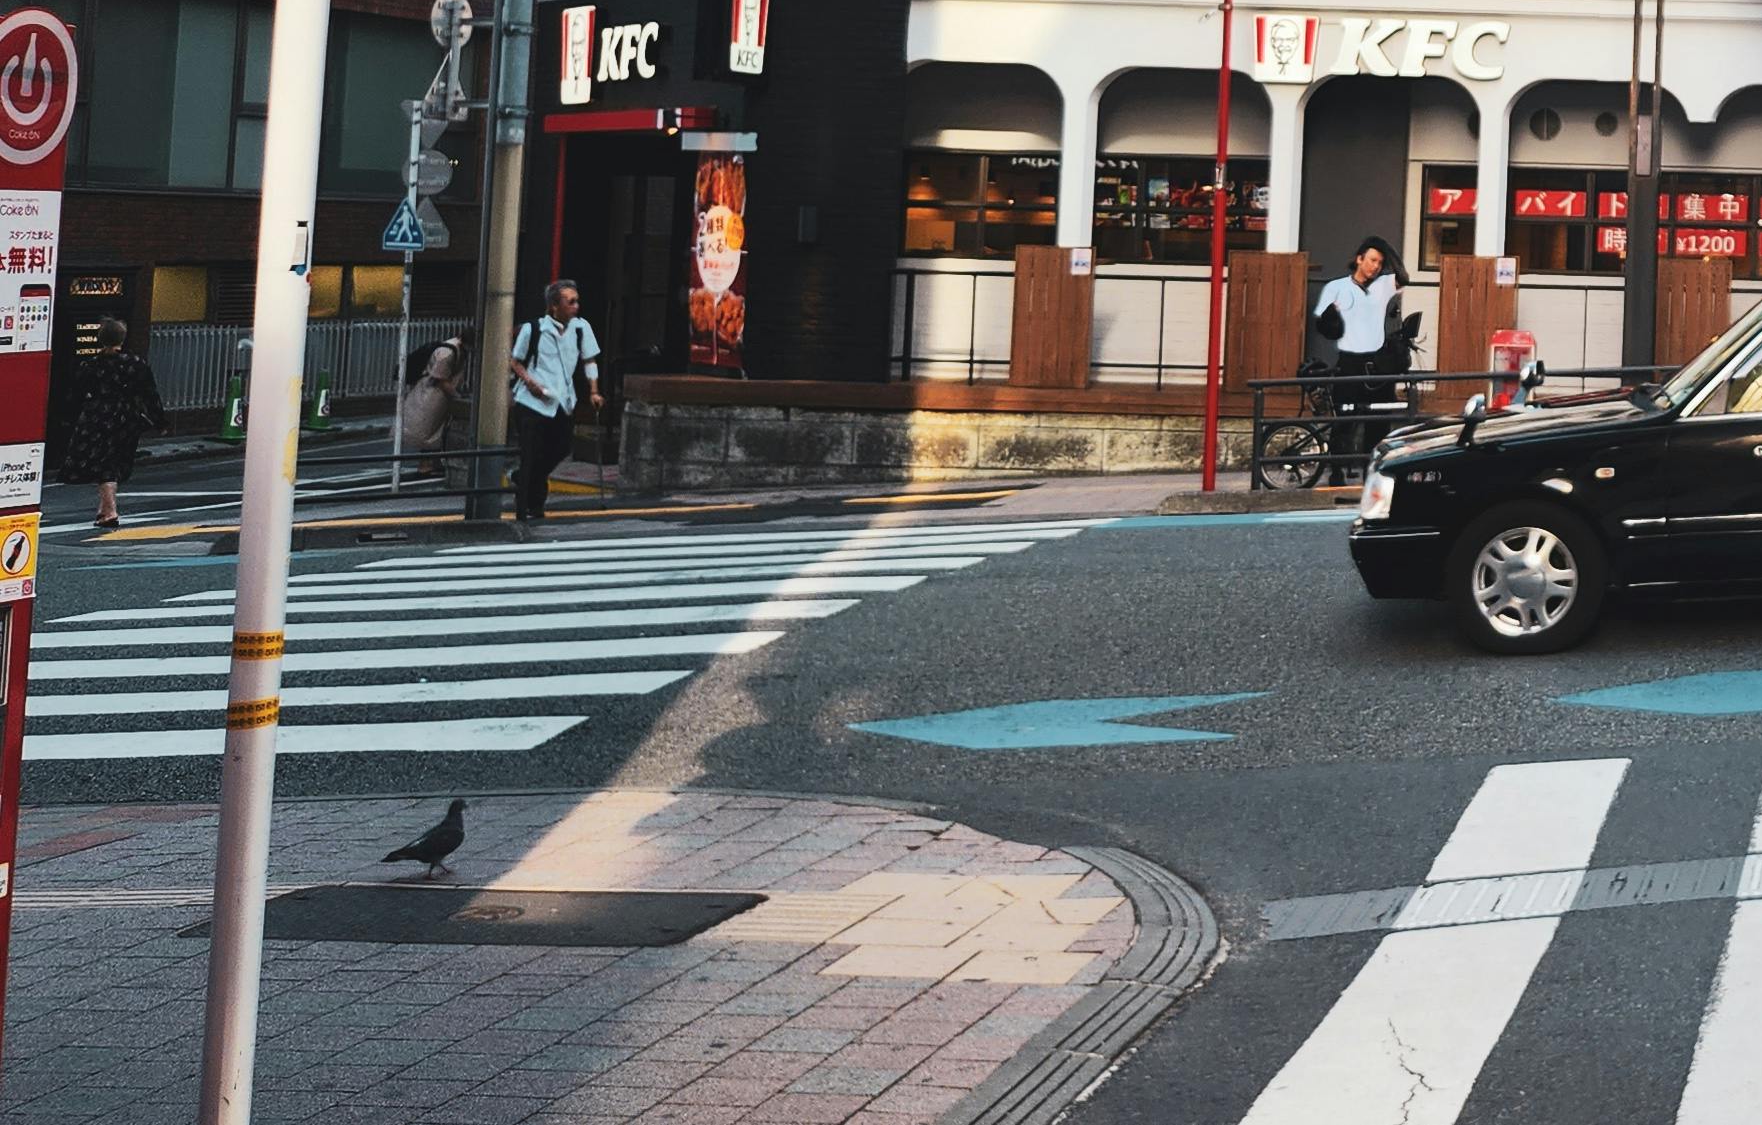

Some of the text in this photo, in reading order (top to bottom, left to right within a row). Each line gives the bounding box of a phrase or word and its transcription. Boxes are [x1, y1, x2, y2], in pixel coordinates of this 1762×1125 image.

[597, 22, 660, 82] KFC
[735, 48, 760, 70] KFC
[1329, 17, 1512, 82] KFC
[1676, 235, 1736, 254] ¥1200
